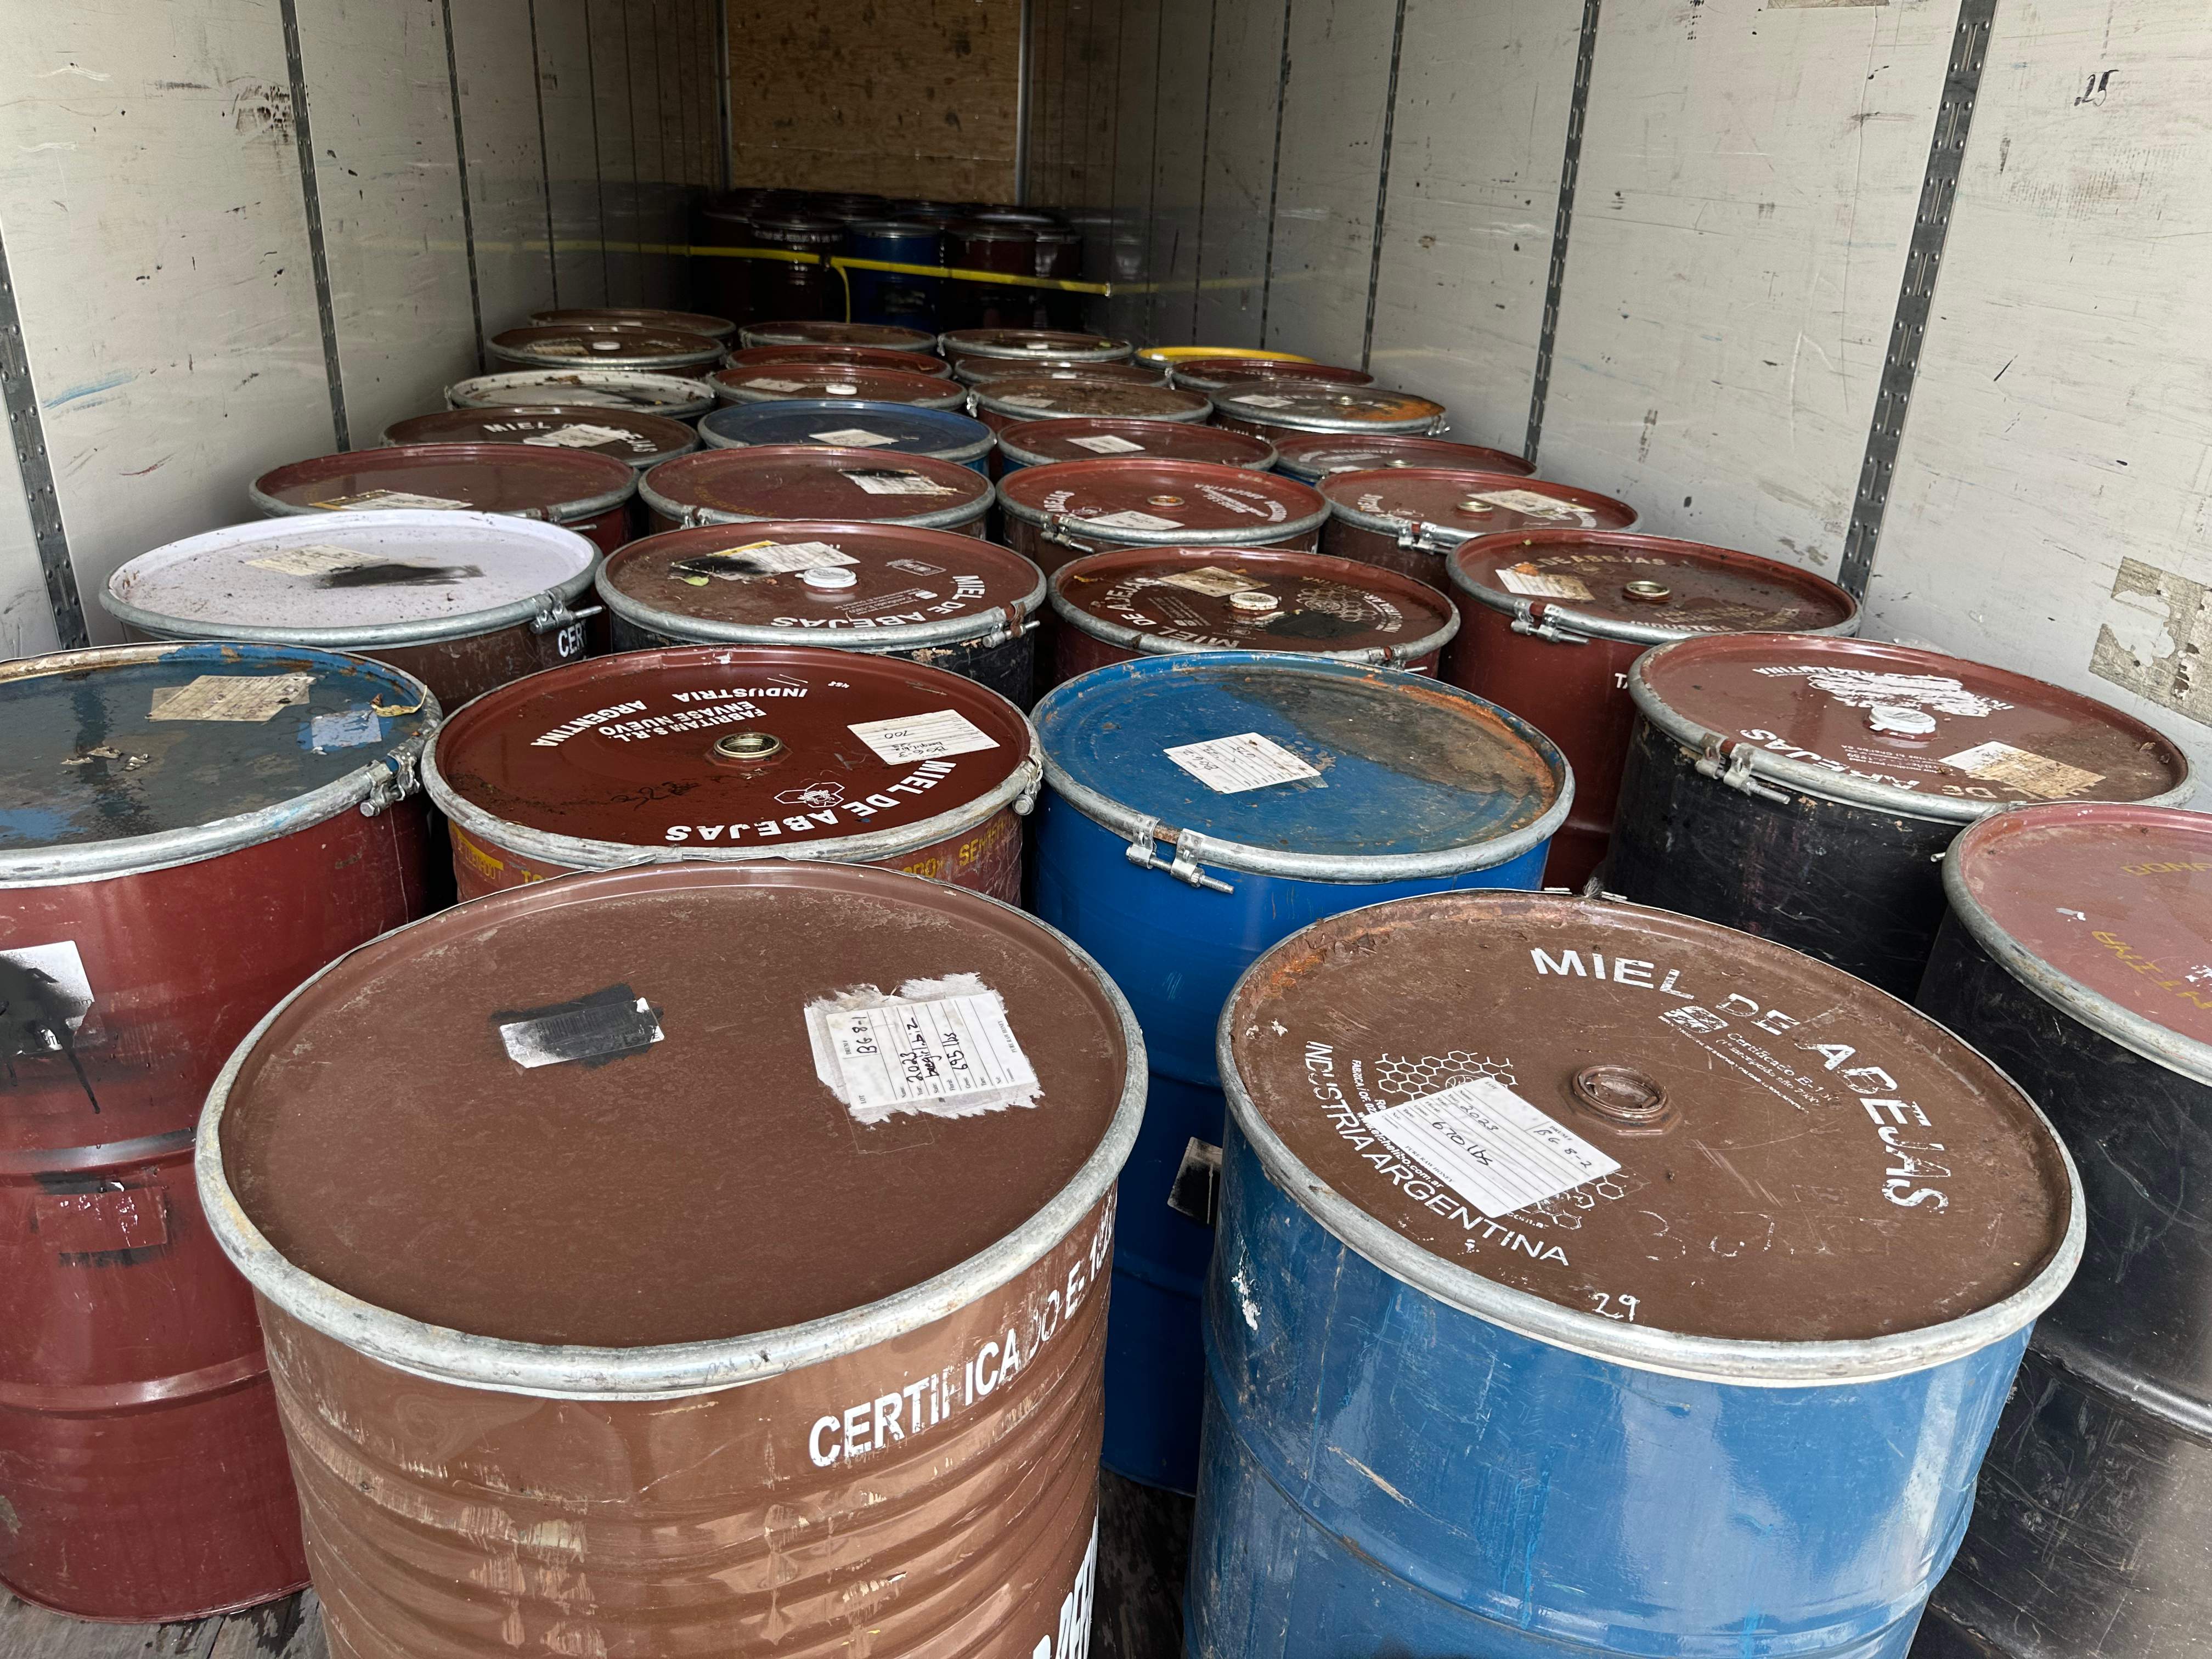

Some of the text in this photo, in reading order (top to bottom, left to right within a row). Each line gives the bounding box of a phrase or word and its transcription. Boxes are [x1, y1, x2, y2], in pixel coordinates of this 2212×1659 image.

[483, 421, 551, 432] MIEL
[951, 575, 985, 600] MIEL
[770, 611, 926, 629] ABEJAS
[927, 601, 966, 614] DE
[1121, 613, 1157, 626] DE
[1158, 626, 1240, 648] MIEL
[531, 687, 808, 747] INDUSTRIA ARGENTINA
[599, 701, 756, 736] ENVASE NUEVO
[668, 708, 768, 732] FABRITAM
[665, 760, 957, 841] MIEL DE ABEJAS
[851, 1017, 877, 1053] BG 8-1
[906, 1017, 942, 1077] beegirl.biz
[900, 1052, 924, 1083] 2023
[947, 1050, 968, 1070] 695
[1485, 1081, 1498, 1090] LOT
[1530, 948, 1951, 1215] MIEL DE ABEJAS
[859, 1094, 867, 1104] LOT
[1460, 1105, 1499, 1131] 2023
[1306, 1041, 1374, 1152] INDUSTRIA
[1362, 1153, 1569, 1266] ARGENTINA
[1432, 1121, 1493, 1166] 670 lbs
[1405, 1146, 1420, 1158] PURE
[1432, 1166, 1455, 1182] HONEY
[1565, 1148, 1592, 1169] 8-2
[1592, 1293, 1641, 1322] 29
